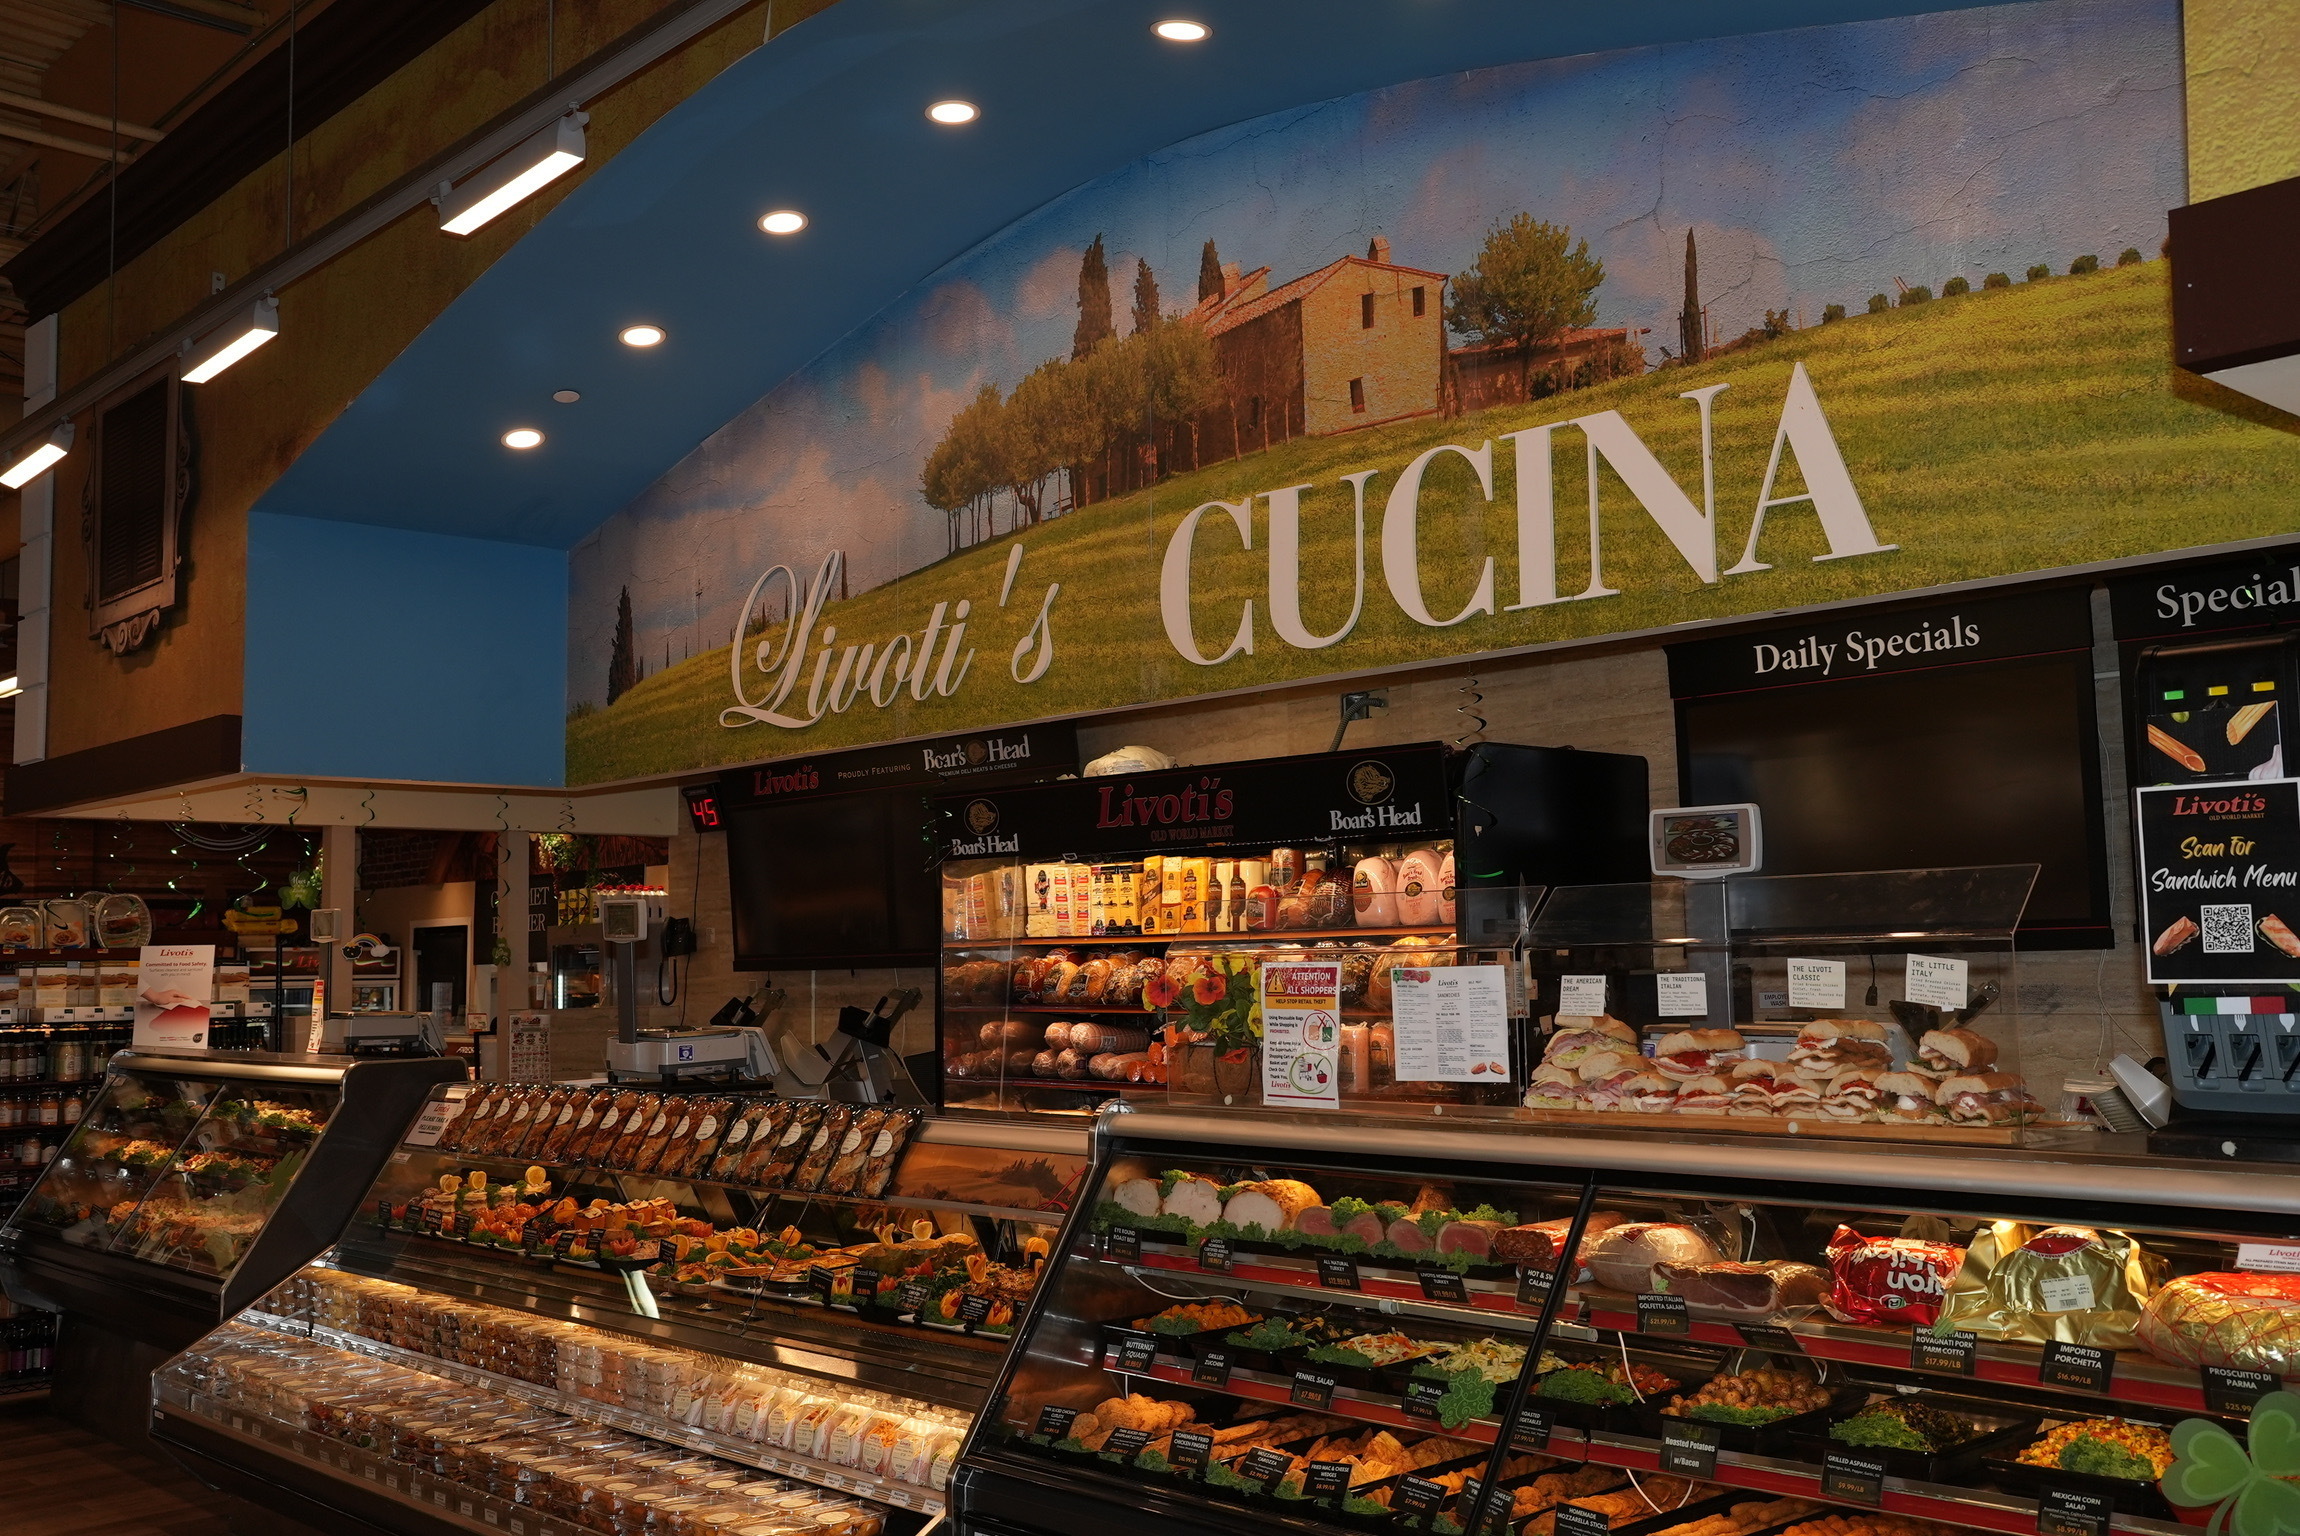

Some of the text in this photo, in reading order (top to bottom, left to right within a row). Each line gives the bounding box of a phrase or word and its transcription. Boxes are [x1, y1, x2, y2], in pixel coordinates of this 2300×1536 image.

[719, 361, 1898, 729] Livoti's CUCINA
[1753, 615, 1980, 676] Daily Specials
[753, 765, 820, 797] Livoti's
[871, 764, 911, 777] FEATURING
[922, 744, 967, 772] Boar's
[988, 733, 1031, 762] Head
[1096, 777, 1234, 829] Livoti's
[2172, 792, 2266, 816] Livoti's
[693, 799, 719, 826] 45
[1329, 801, 1423, 831] Boar's Head
[1150, 825, 1235, 842] OLD WORLD MARKET
[952, 832, 1020, 857] Boar's Head
[2180, 835, 2226, 860] Scan
[2151, 863, 2298, 892] Sandwich Menu
[160, 948, 194, 957] Livoti's
[1928, 962, 1954, 970] LITTLE
[1292, 972, 1331, 981] ATTENTION
[1911, 969, 1933, 977] ITALY
[1287, 986, 1336, 995] ALL SHOPPERS
[1329, 1264, 1345, 1272] TURKEY
[1527, 1269, 1540, 1278] HOT
[1433, 1278, 1449, 1286] TURKEY
[1528, 1278, 1551, 1289] CALABR
[1637, 1294, 1683, 1303] IMPORTED ITALIAN
[1666, 1303, 1686, 1311] SALAMI
[1916, 1327, 1975, 1342] IMPO TALIAN
[1125, 1341, 1155, 1352] BUTTERNUT
[1915, 1336, 1974, 1350] ROVAGNATI PORK
[1125, 1350, 1149, 1360] SQUASH
[1922, 1345, 1965, 1357] PARM COTTO
[2060, 1344, 2101, 1359] IMPORTED
[1924, 1357, 1961, 1369] $17.99/LB
[2054, 1353, 2103, 1370] PORCHETTA
[1295, 1371, 1335, 1387] FENNEL SALAD
[2056, 1372, 2093, 1385] $16.99/LB
[2209, 1366, 2272, 1382] PROSCUITTO DI
[2226, 1378, 2258, 1390] PARMA
[1300, 1390, 1323, 1402] $7.99/LB
[1430, 1386, 1443, 1396] SALAD
[1174, 1432, 1196, 1441] HOMEMADE
[1172, 1439, 1208, 1450] CHICKEN FINGERS
[1664, 1436, 1715, 1453] Roasted Potatoes
[1673, 1455, 1700, 1468] w/Bacon
[1827, 1454, 1883, 1472] GRILLED ASPARAGUS
[1406, 1475, 1442, 1492] FRIED BROCCOLI
[1837, 1481, 1865, 1493] $9.99/LB
[1467, 1479, 1511, 1502] HOME CHEESE
[2051, 1491, 2101, 1506] MEXICAN CORN
[2064, 1501, 2086, 1511] SALAD
[1568, 1507, 1597, 1519] HOMEMADE
[1556, 1512, 1590, 1526] MOZZARELLA
[1589, 1521, 1608, 1531] STICKS
[2056, 1524, 2088, 1536] $8.99/LB
